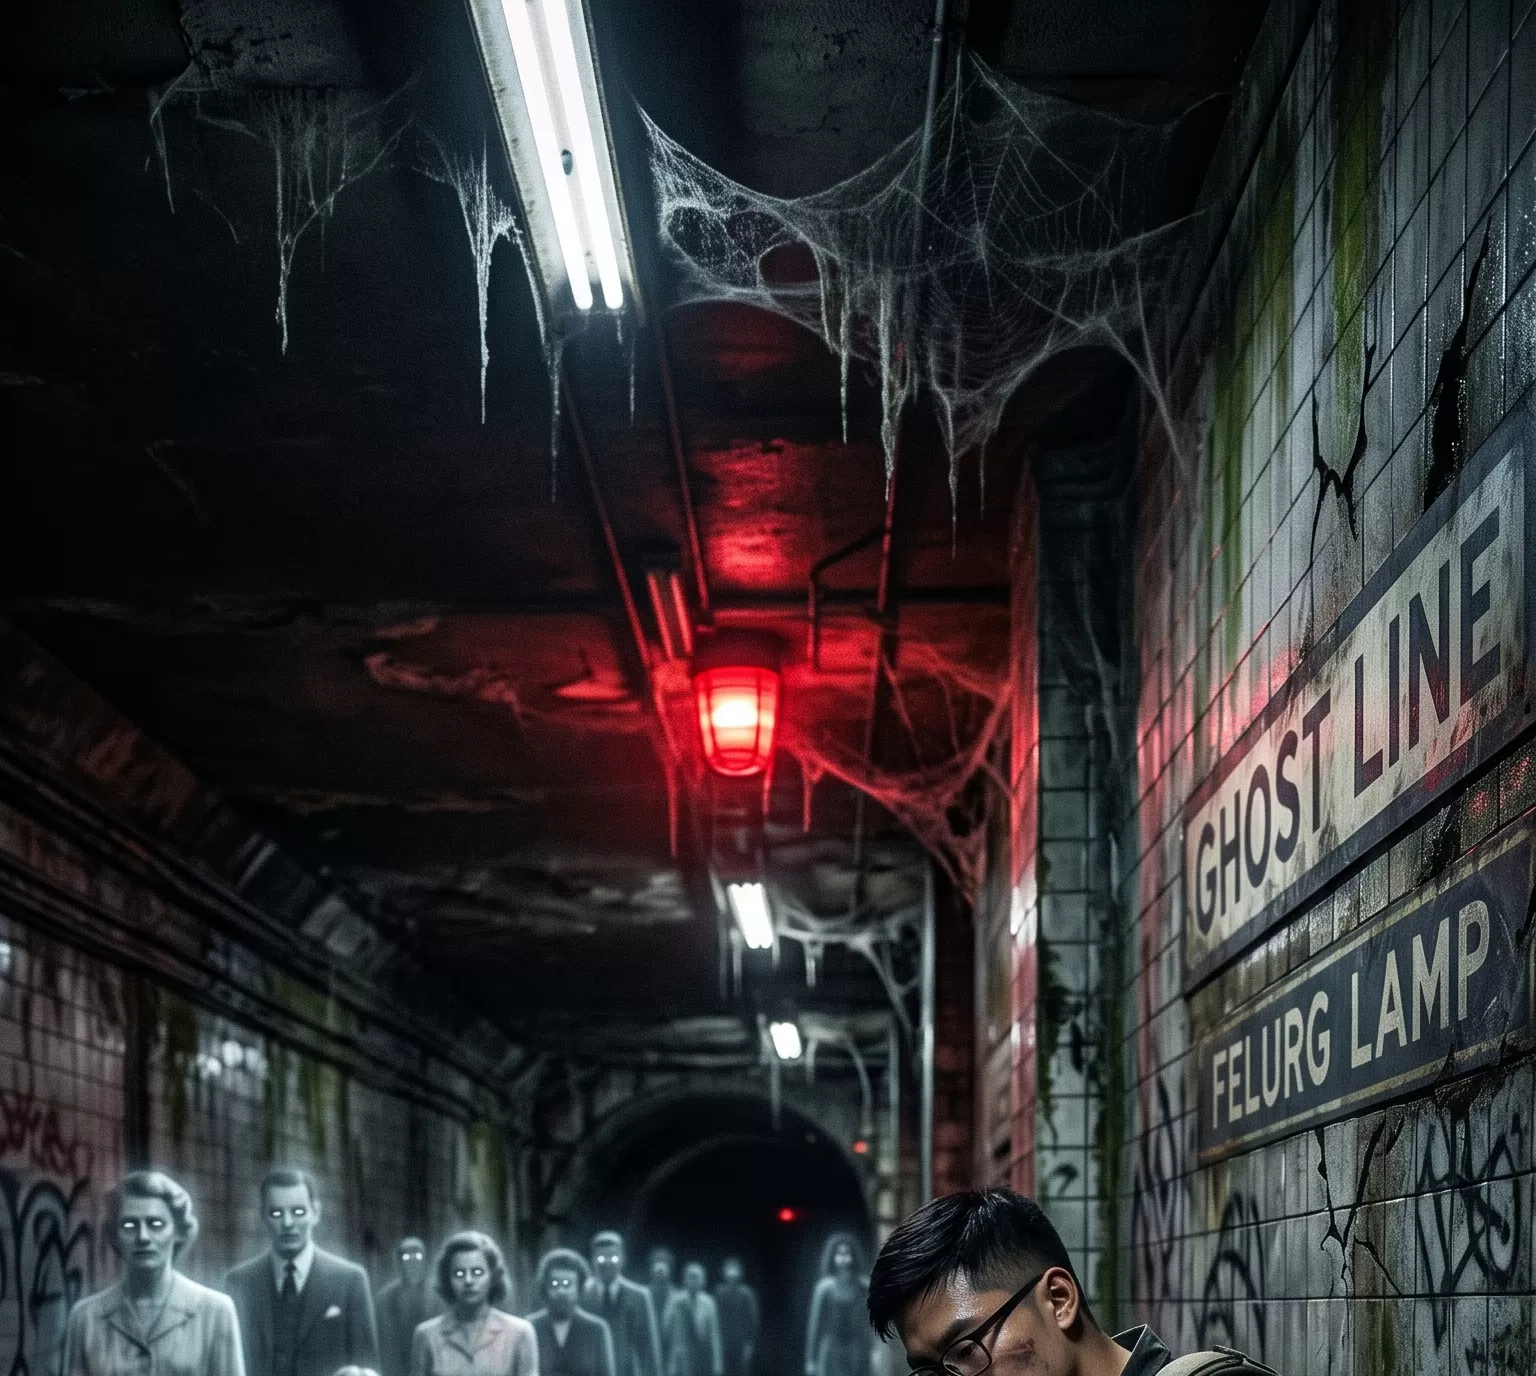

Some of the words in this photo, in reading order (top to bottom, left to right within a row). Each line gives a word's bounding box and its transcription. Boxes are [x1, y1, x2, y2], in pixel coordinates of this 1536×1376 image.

[1196, 690, 1330, 932] GHOST
[1354, 511, 1500, 799] LINE
[1212, 991, 1331, 1130] FELURG
[1351, 900, 1490, 1069] LAMP
